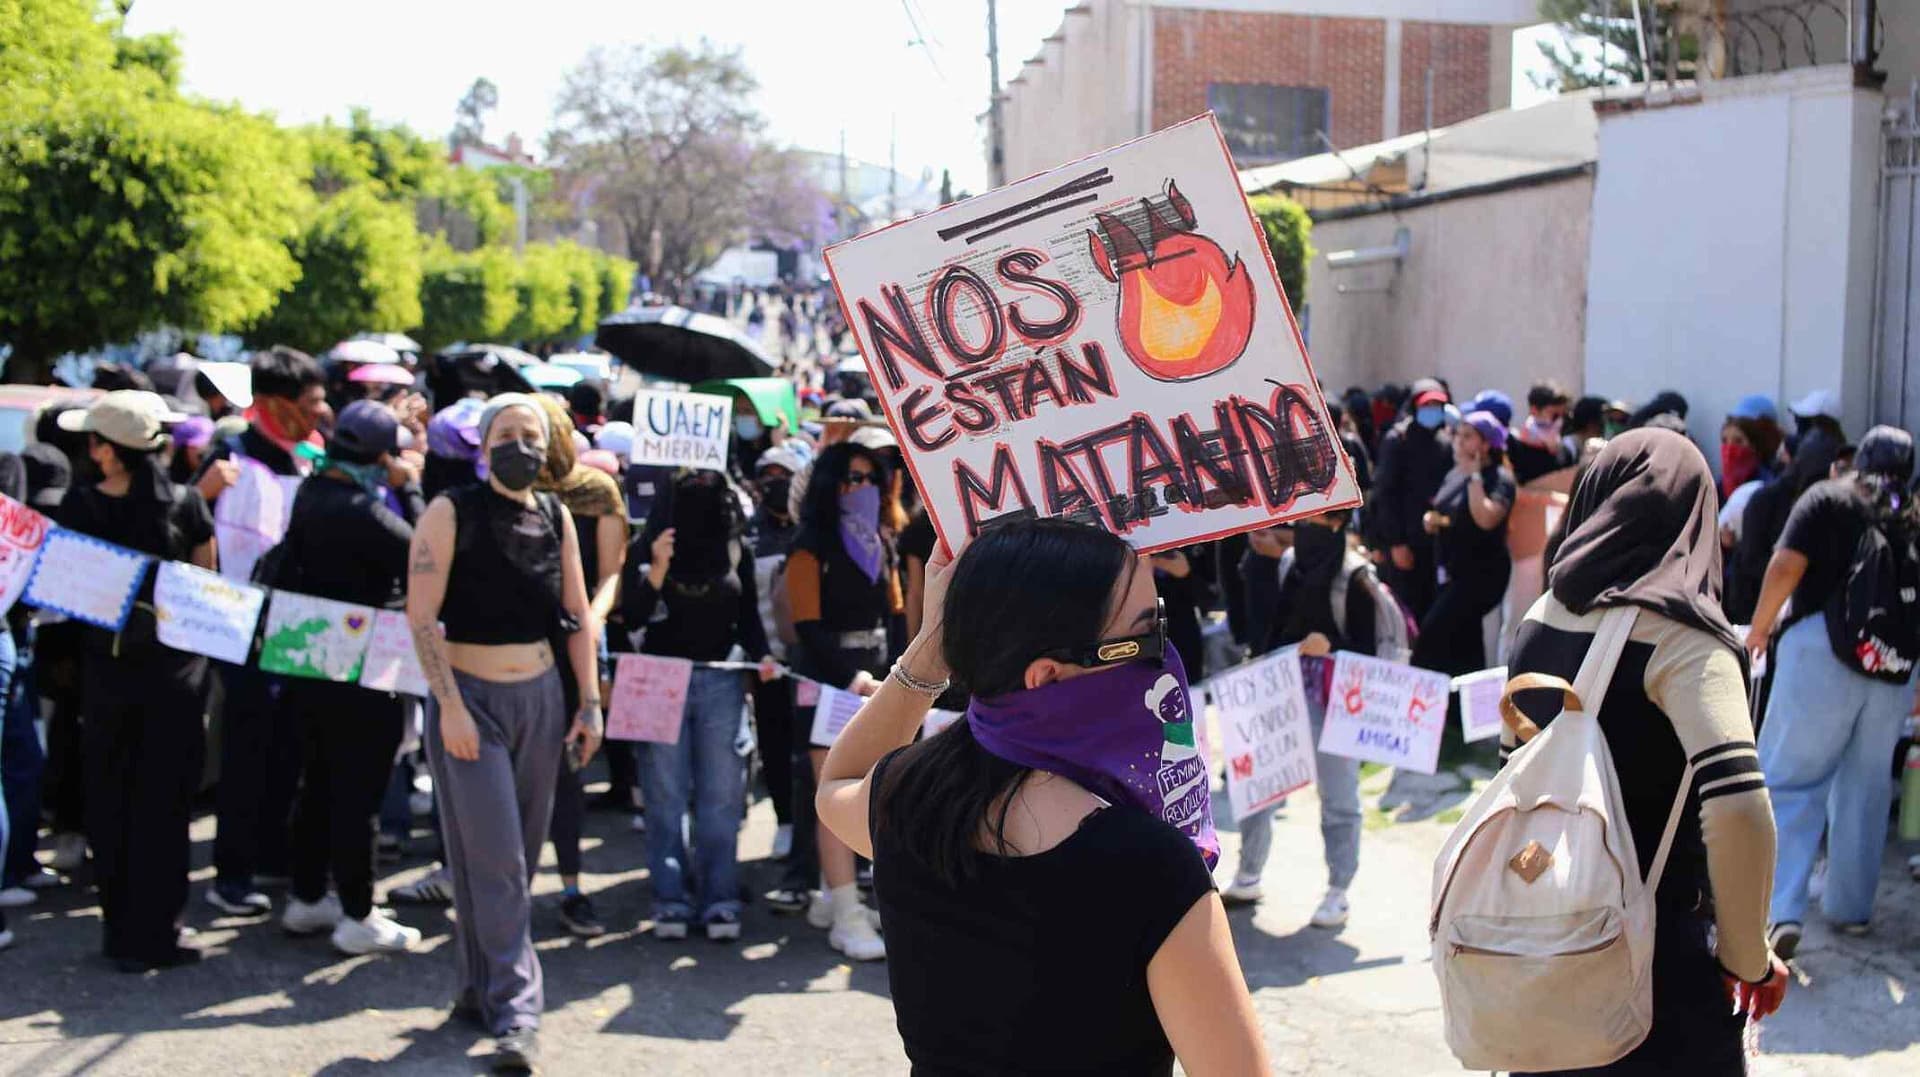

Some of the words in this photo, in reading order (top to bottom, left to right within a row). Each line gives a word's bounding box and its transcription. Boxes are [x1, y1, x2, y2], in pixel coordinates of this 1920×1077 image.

[856, 247, 1085, 392] NOS
[648, 397, 724, 440] UAEM
[898, 341, 1119, 452] ESTÁN
[643, 439, 722, 463] MIERDA
[952, 379, 1338, 536] MATANDO
[1213, 674, 1257, 711] HOY
[1263, 658, 1294, 698] SER
[1357, 728, 1410, 756] AMIGAS
